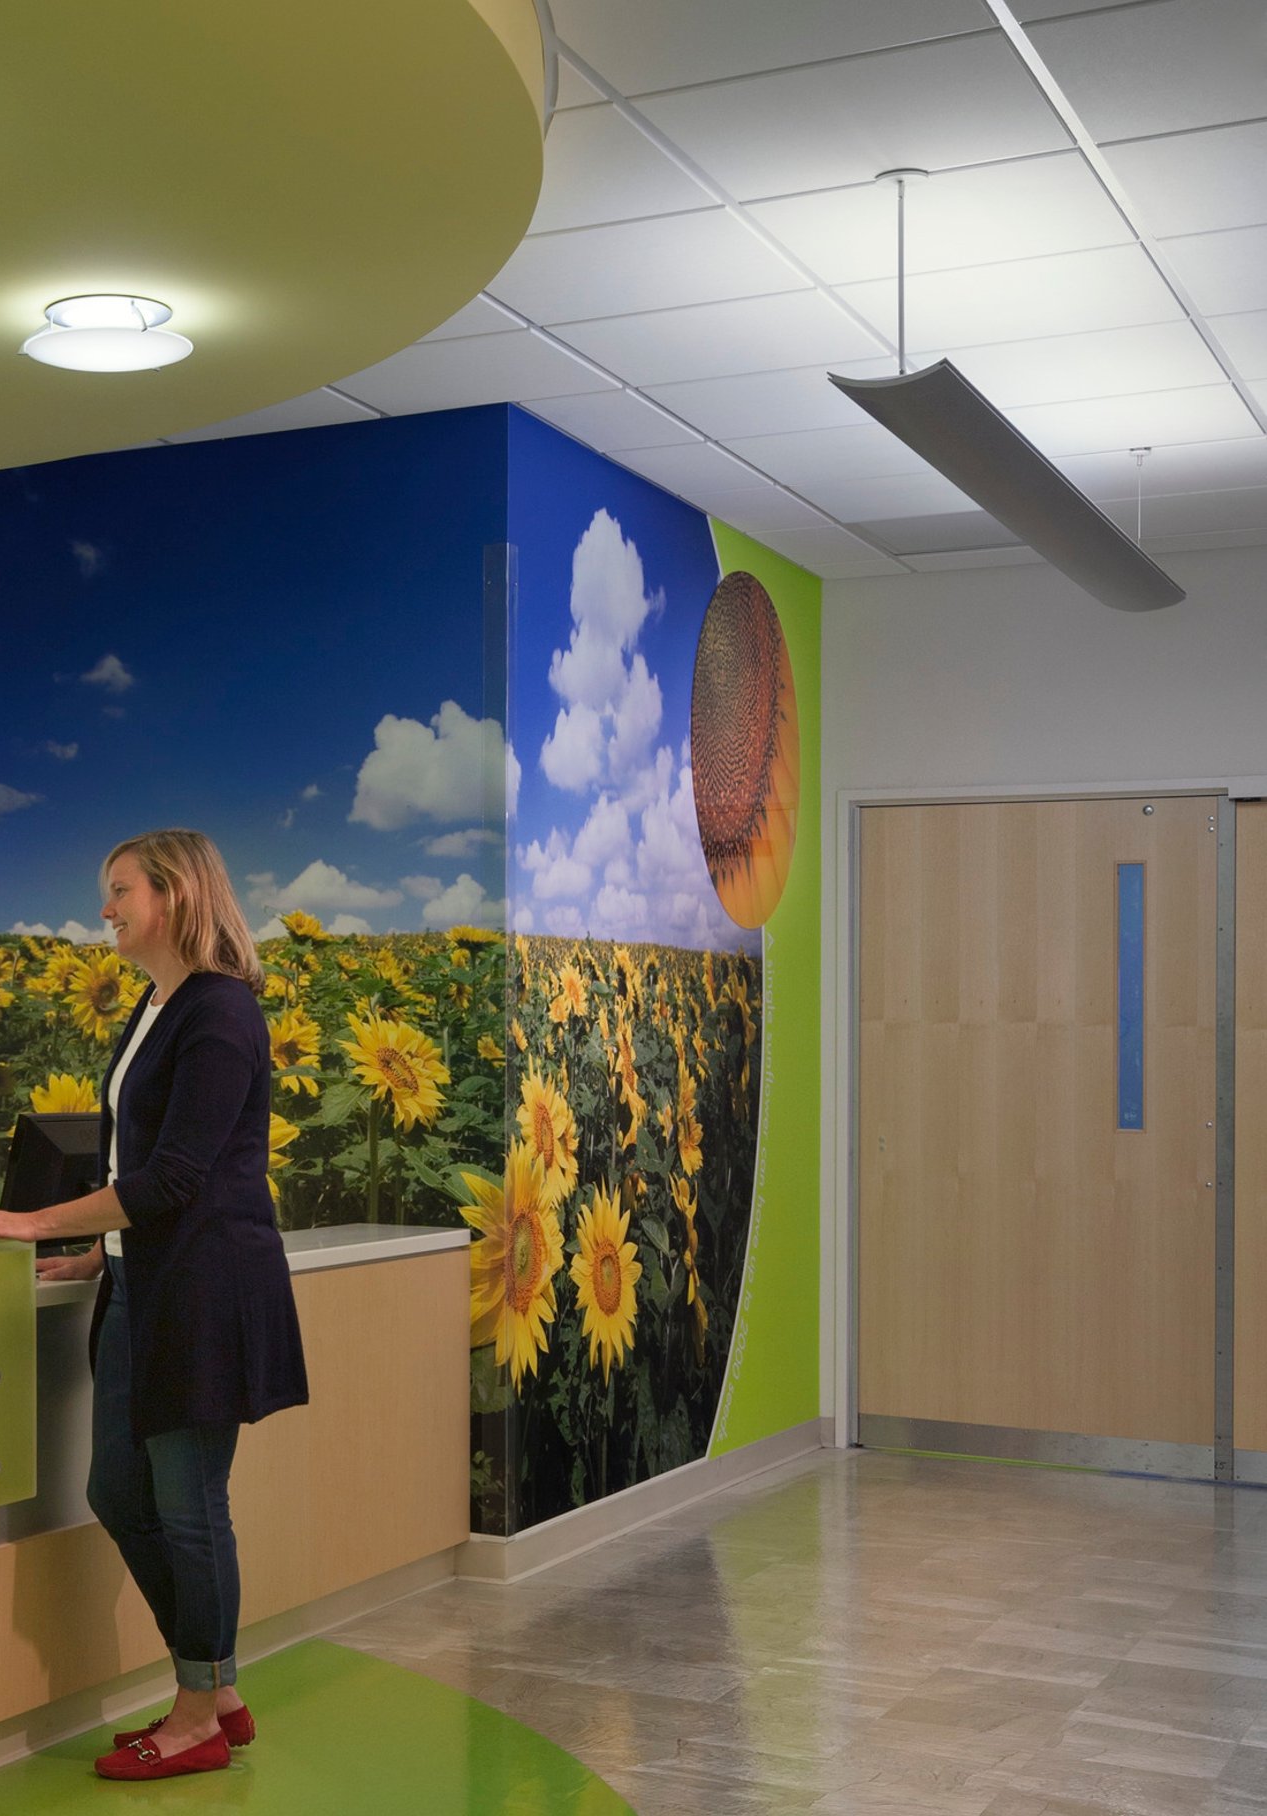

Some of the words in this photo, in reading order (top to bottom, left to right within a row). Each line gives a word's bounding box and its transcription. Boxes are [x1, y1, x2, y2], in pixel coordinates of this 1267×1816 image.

[766, 931, 774, 951] A
[765, 959, 775, 1024] single
[763, 1032, 775, 1137] sunflower
[759, 1146, 767, 1188] can
[753, 1194, 765, 1249] have
[747, 1256, 756, 1284] up
[743, 1290, 752, 1311] to
[733, 1318, 748, 1380] 2000
